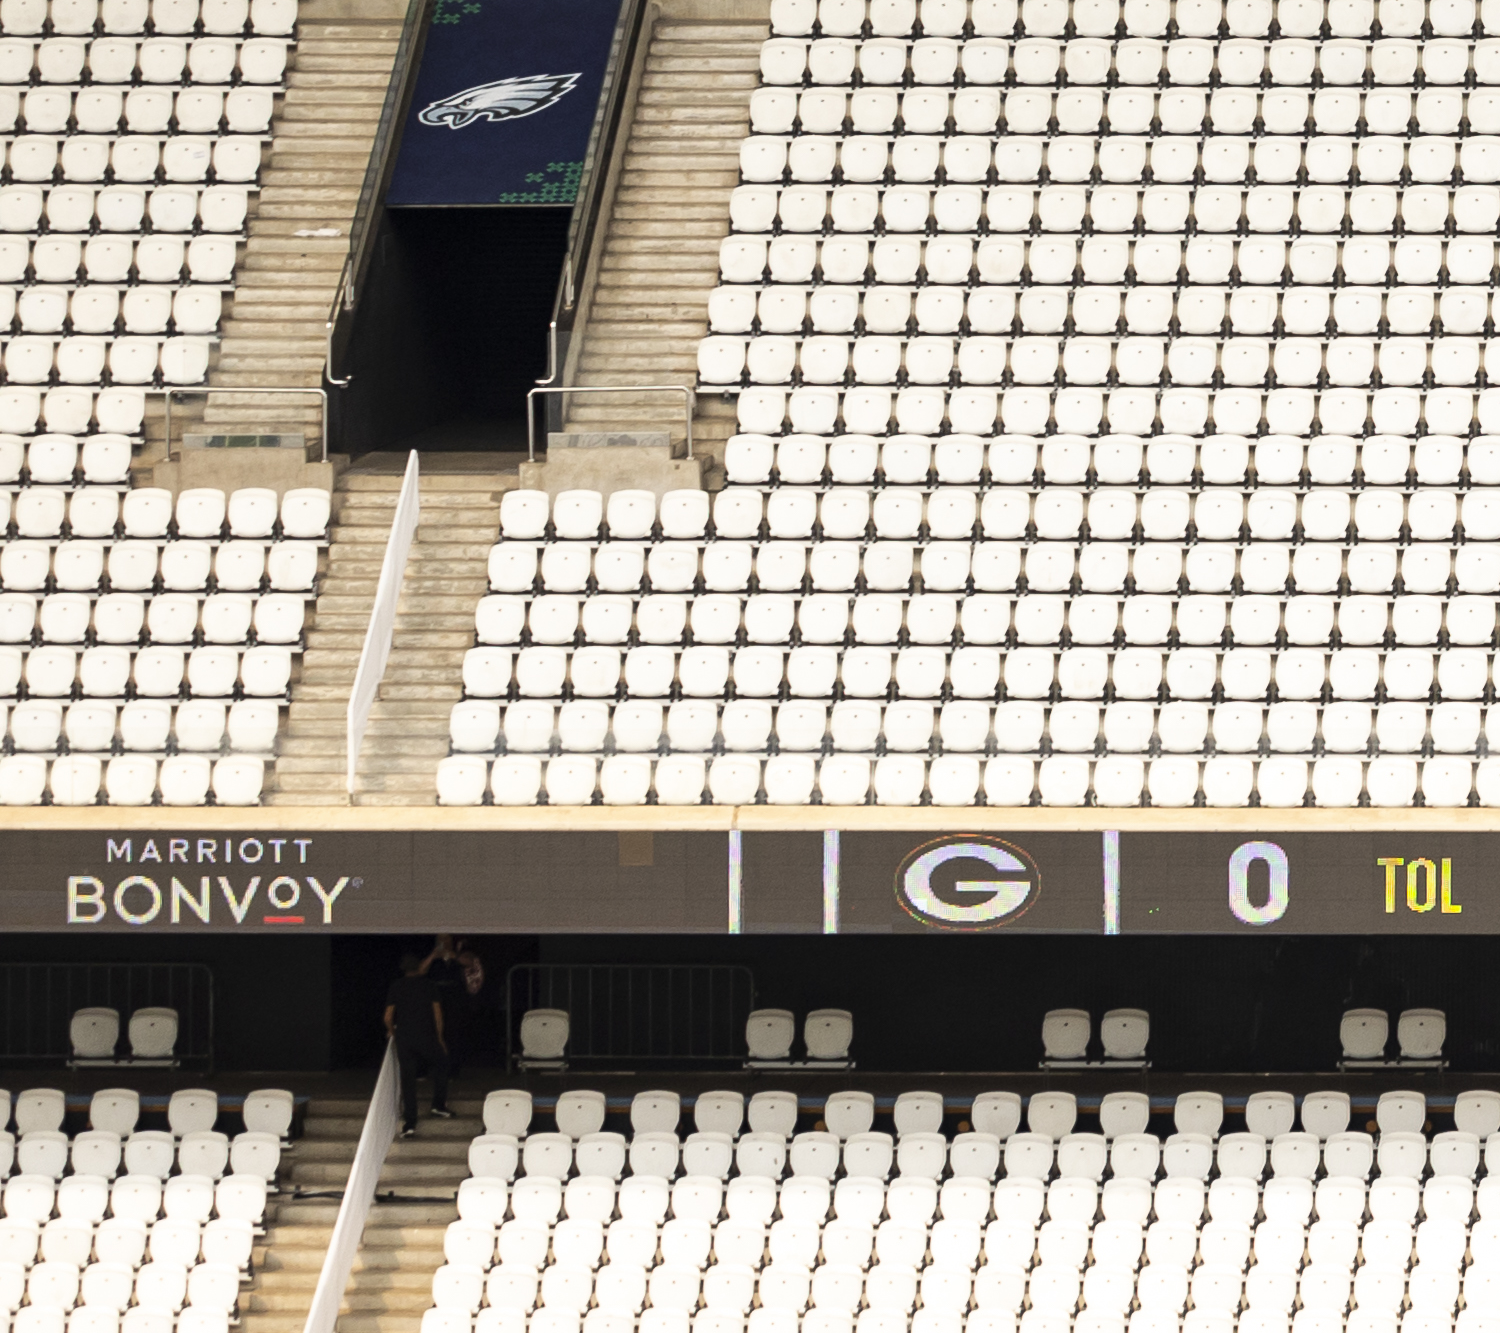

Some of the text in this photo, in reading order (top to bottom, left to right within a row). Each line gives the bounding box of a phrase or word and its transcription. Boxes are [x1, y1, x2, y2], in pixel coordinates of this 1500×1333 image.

[105, 837, 314, 865] MARRIOTT
[1227, 840, 1290, 927] 0
[1376, 857, 1463, 916] TOL
